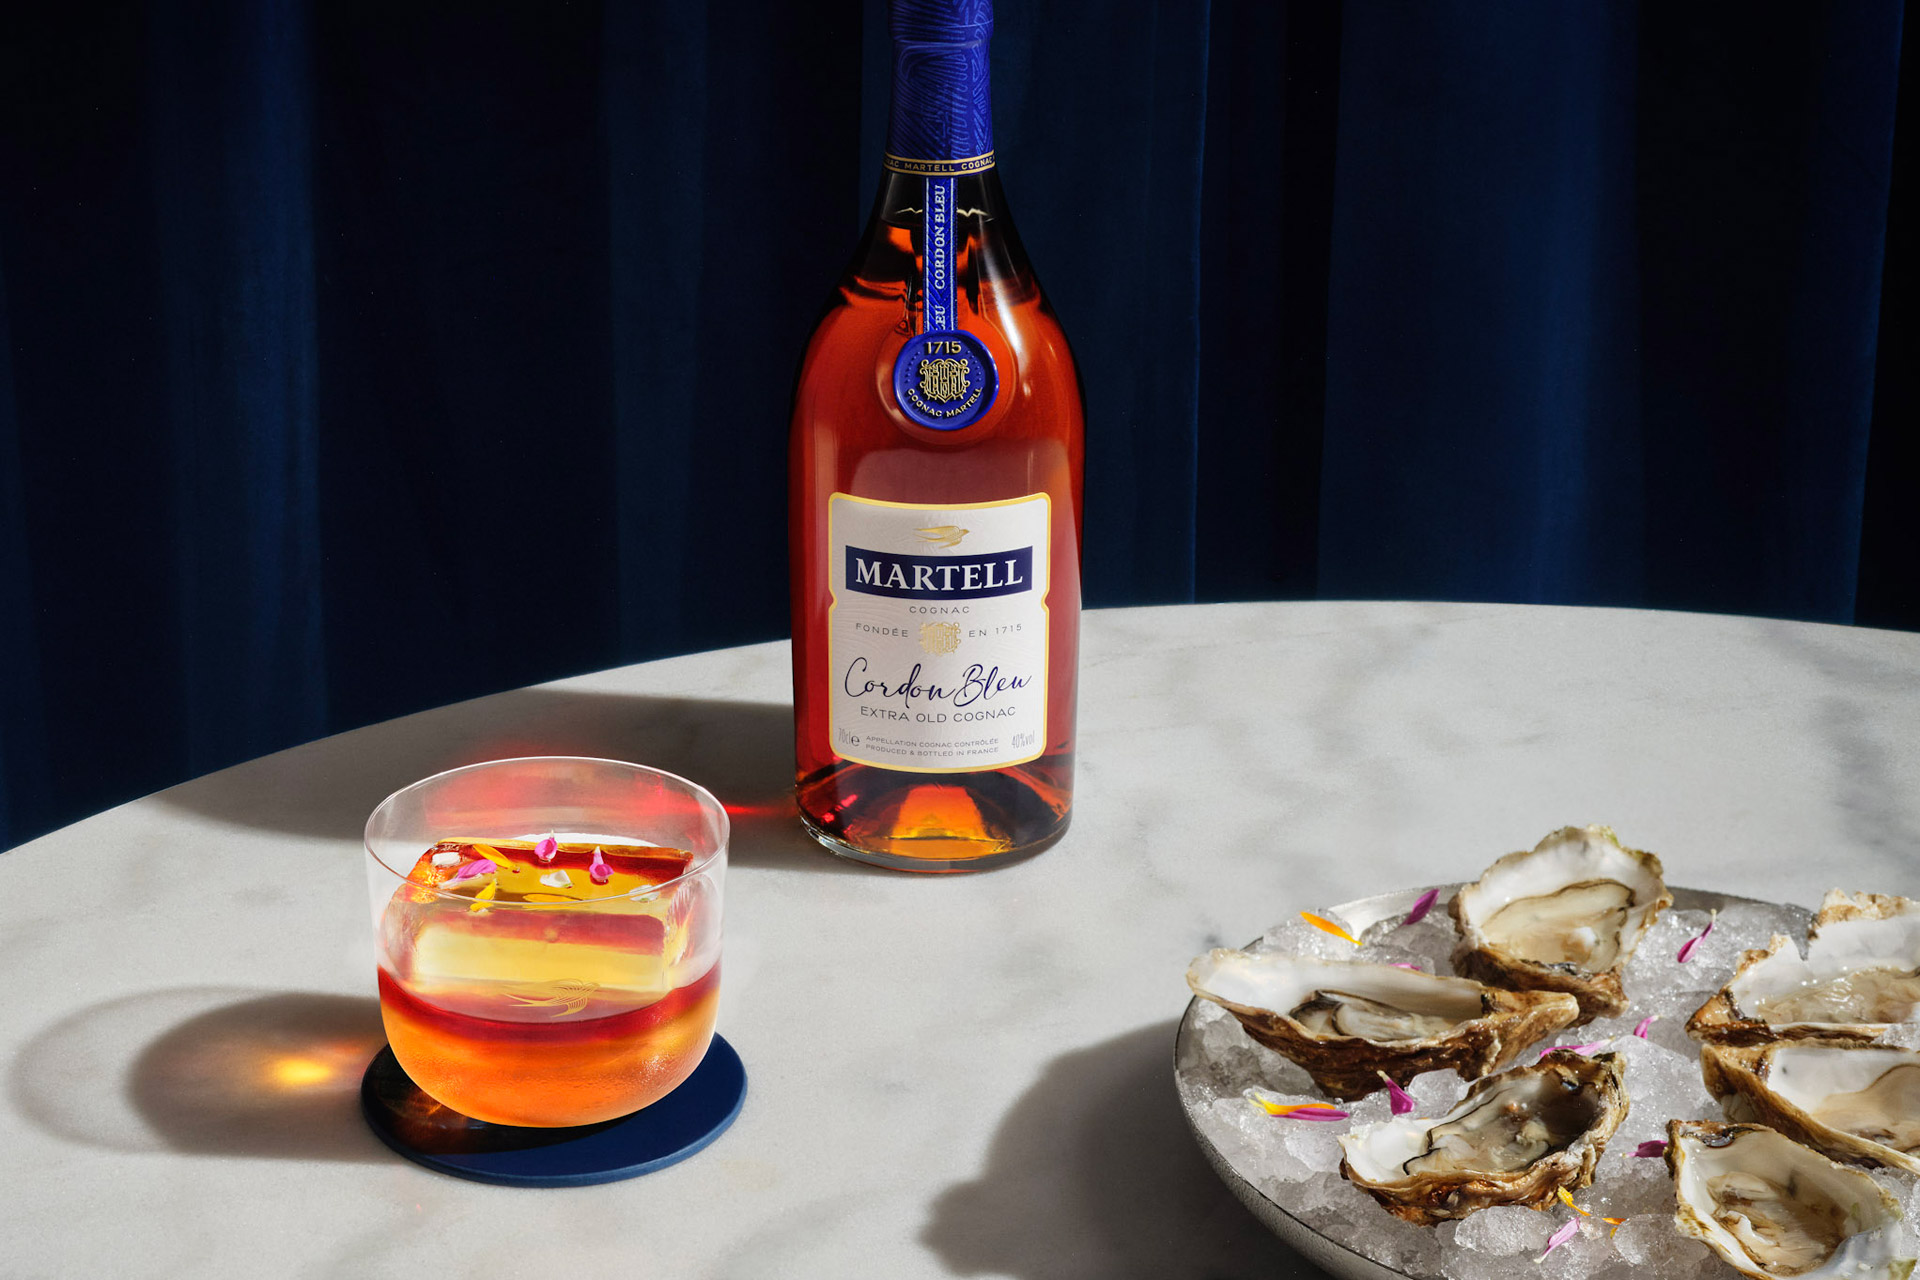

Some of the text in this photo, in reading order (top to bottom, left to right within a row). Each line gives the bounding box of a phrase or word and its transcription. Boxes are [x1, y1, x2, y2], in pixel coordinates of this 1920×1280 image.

[904, 162, 955, 172] MARTELL
[961, 156, 993, 170] COGNAC
[934, 185, 946, 290] CORDON BLEU
[926, 340, 962, 354] 1715
[908, 387, 983, 418] COGNAC MARTELL
[855, 557, 1023, 591] MARTELL
[909, 605, 970, 614] COGNAC
[855, 622, 1022, 638] FONDÉE EN 1715
[844, 656, 1032, 709] Cordon Bleu
[860, 705, 1016, 723] EXTRA OLD COGNAC
[865, 744, 907, 755] PRODUCED
[967, 746, 999, 755] FRANCE
[866, 735, 917, 747] APPELLATION
[954, 737, 999, 748] CONTRÔLÉE
